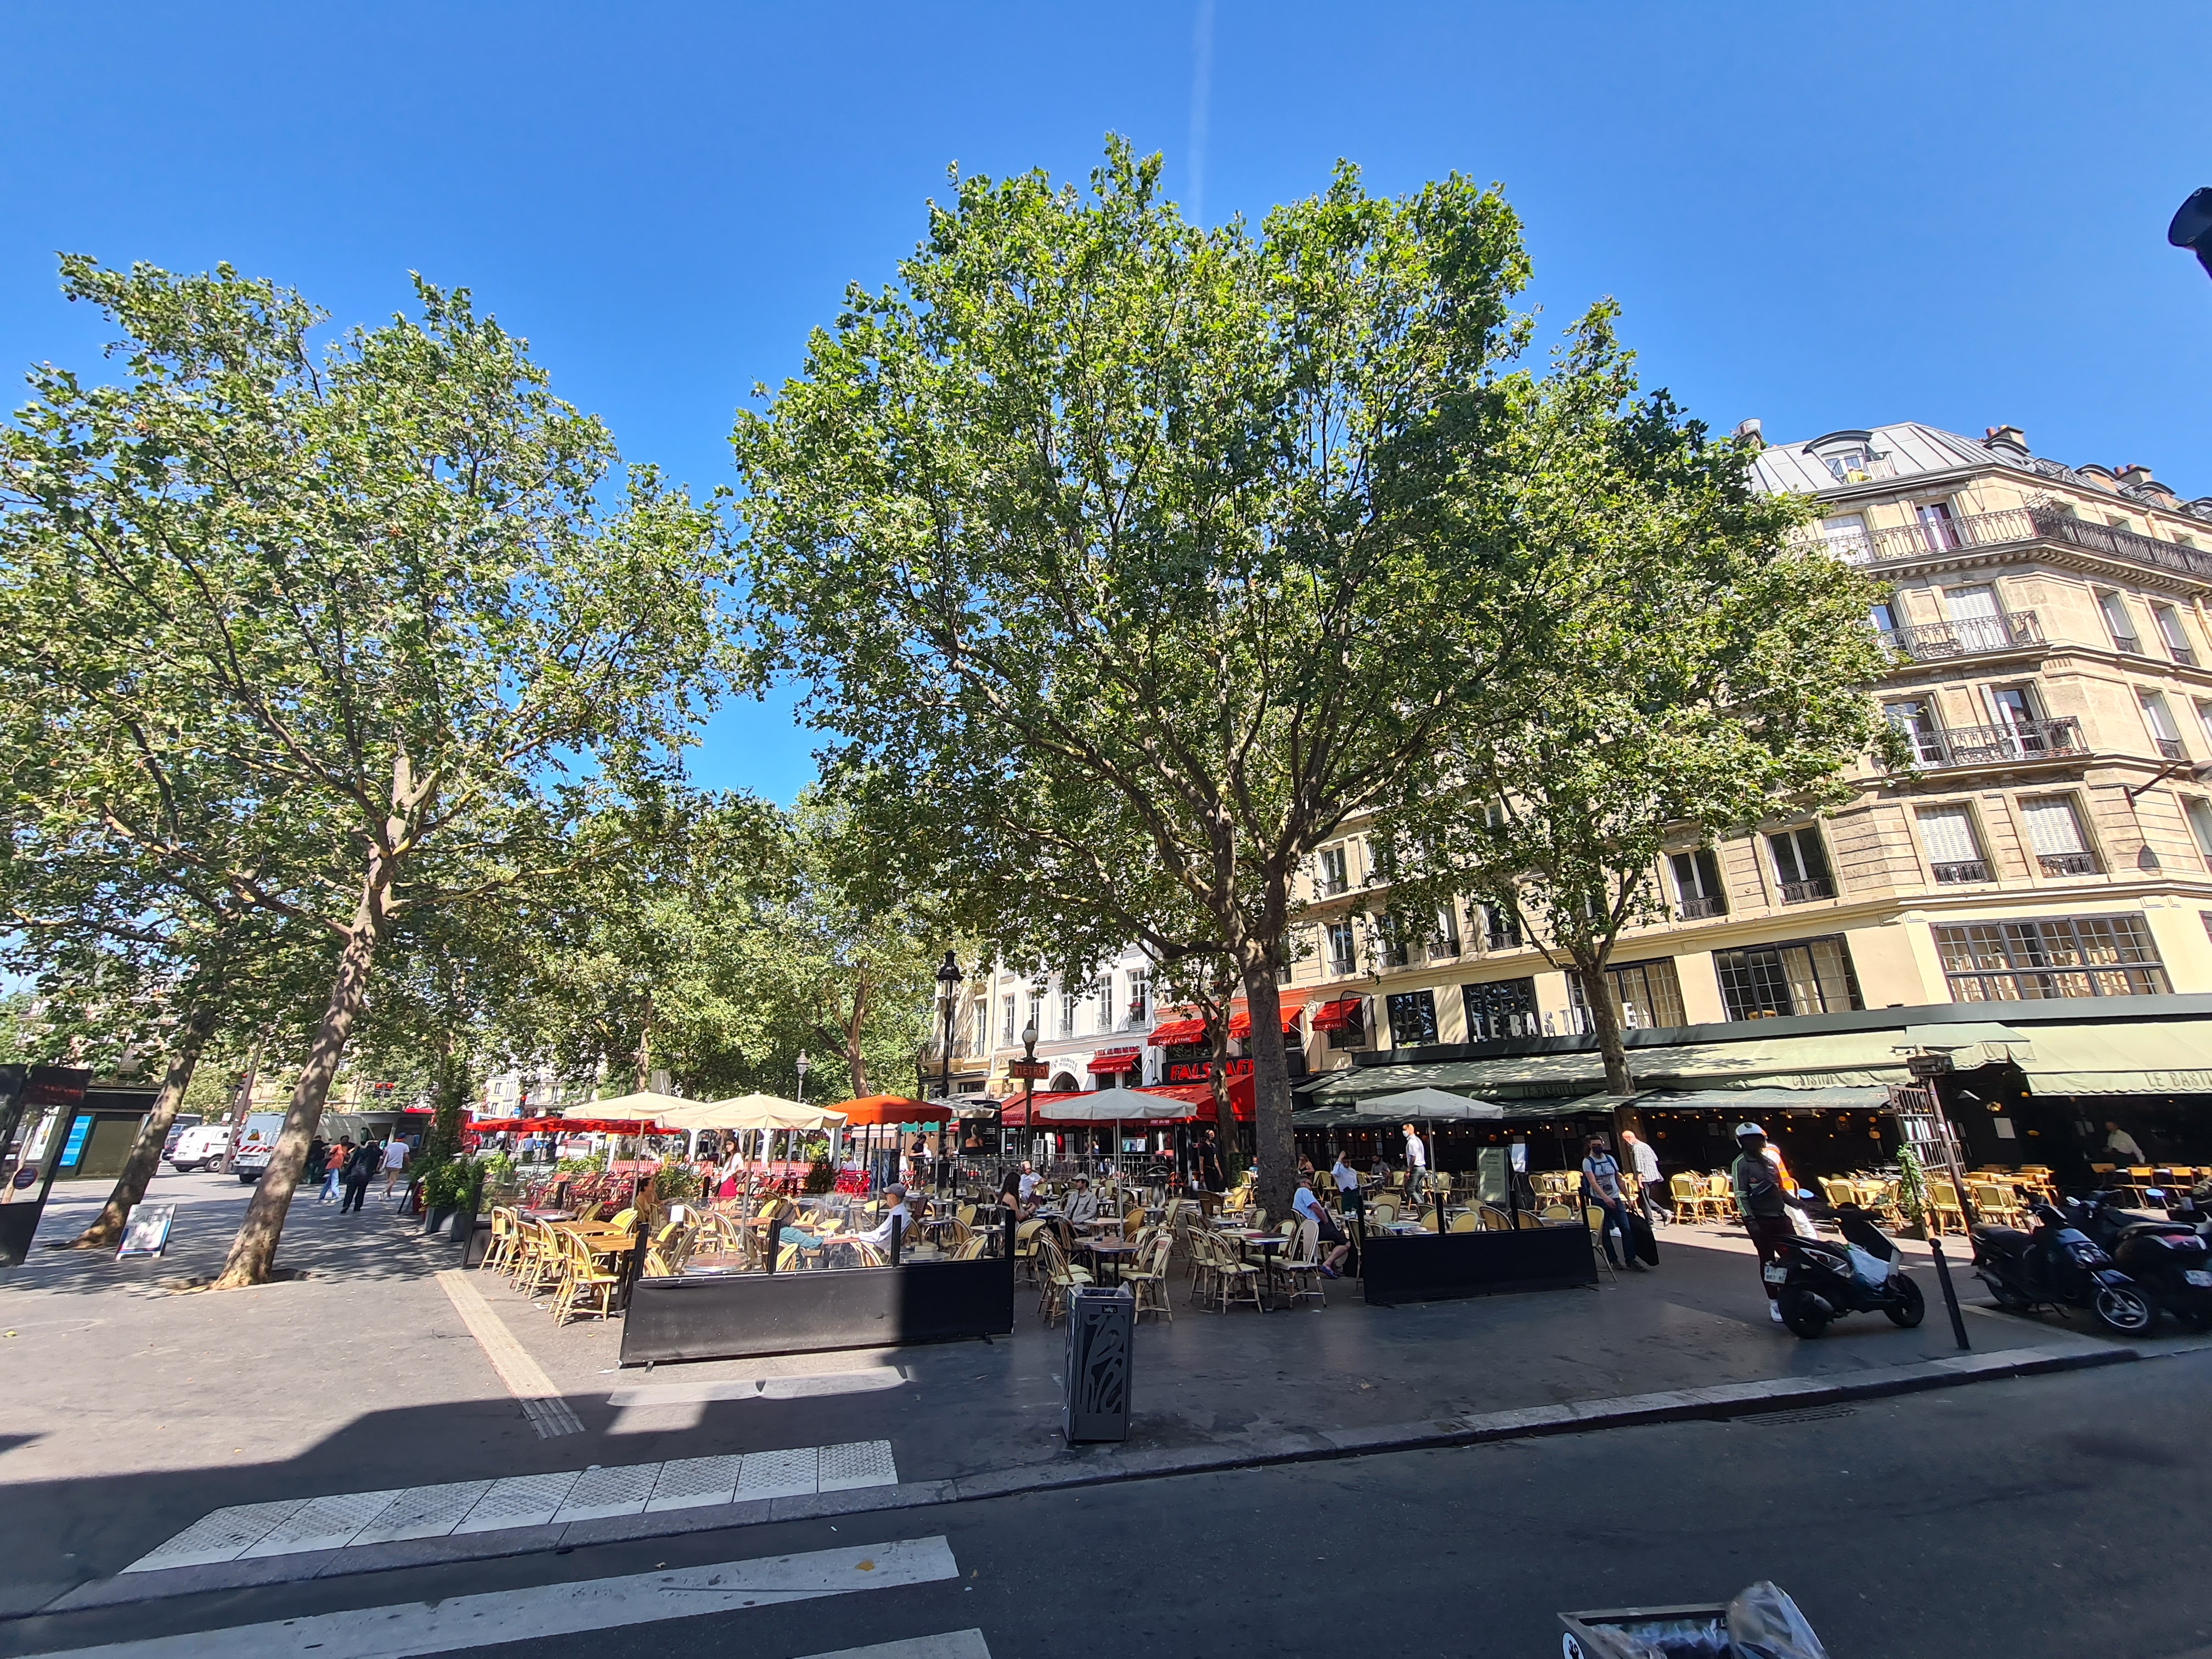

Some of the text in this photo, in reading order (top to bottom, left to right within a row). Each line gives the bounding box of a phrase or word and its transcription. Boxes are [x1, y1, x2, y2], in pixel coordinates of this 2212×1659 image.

[1475, 1002, 1637, 1040] LE BASTIE
[1170, 1059, 1254, 1081] FALSAF
[2144, 1071, 2212, 1087] LE BASTI
[1792, 1074, 1837, 1086] CUISINE
